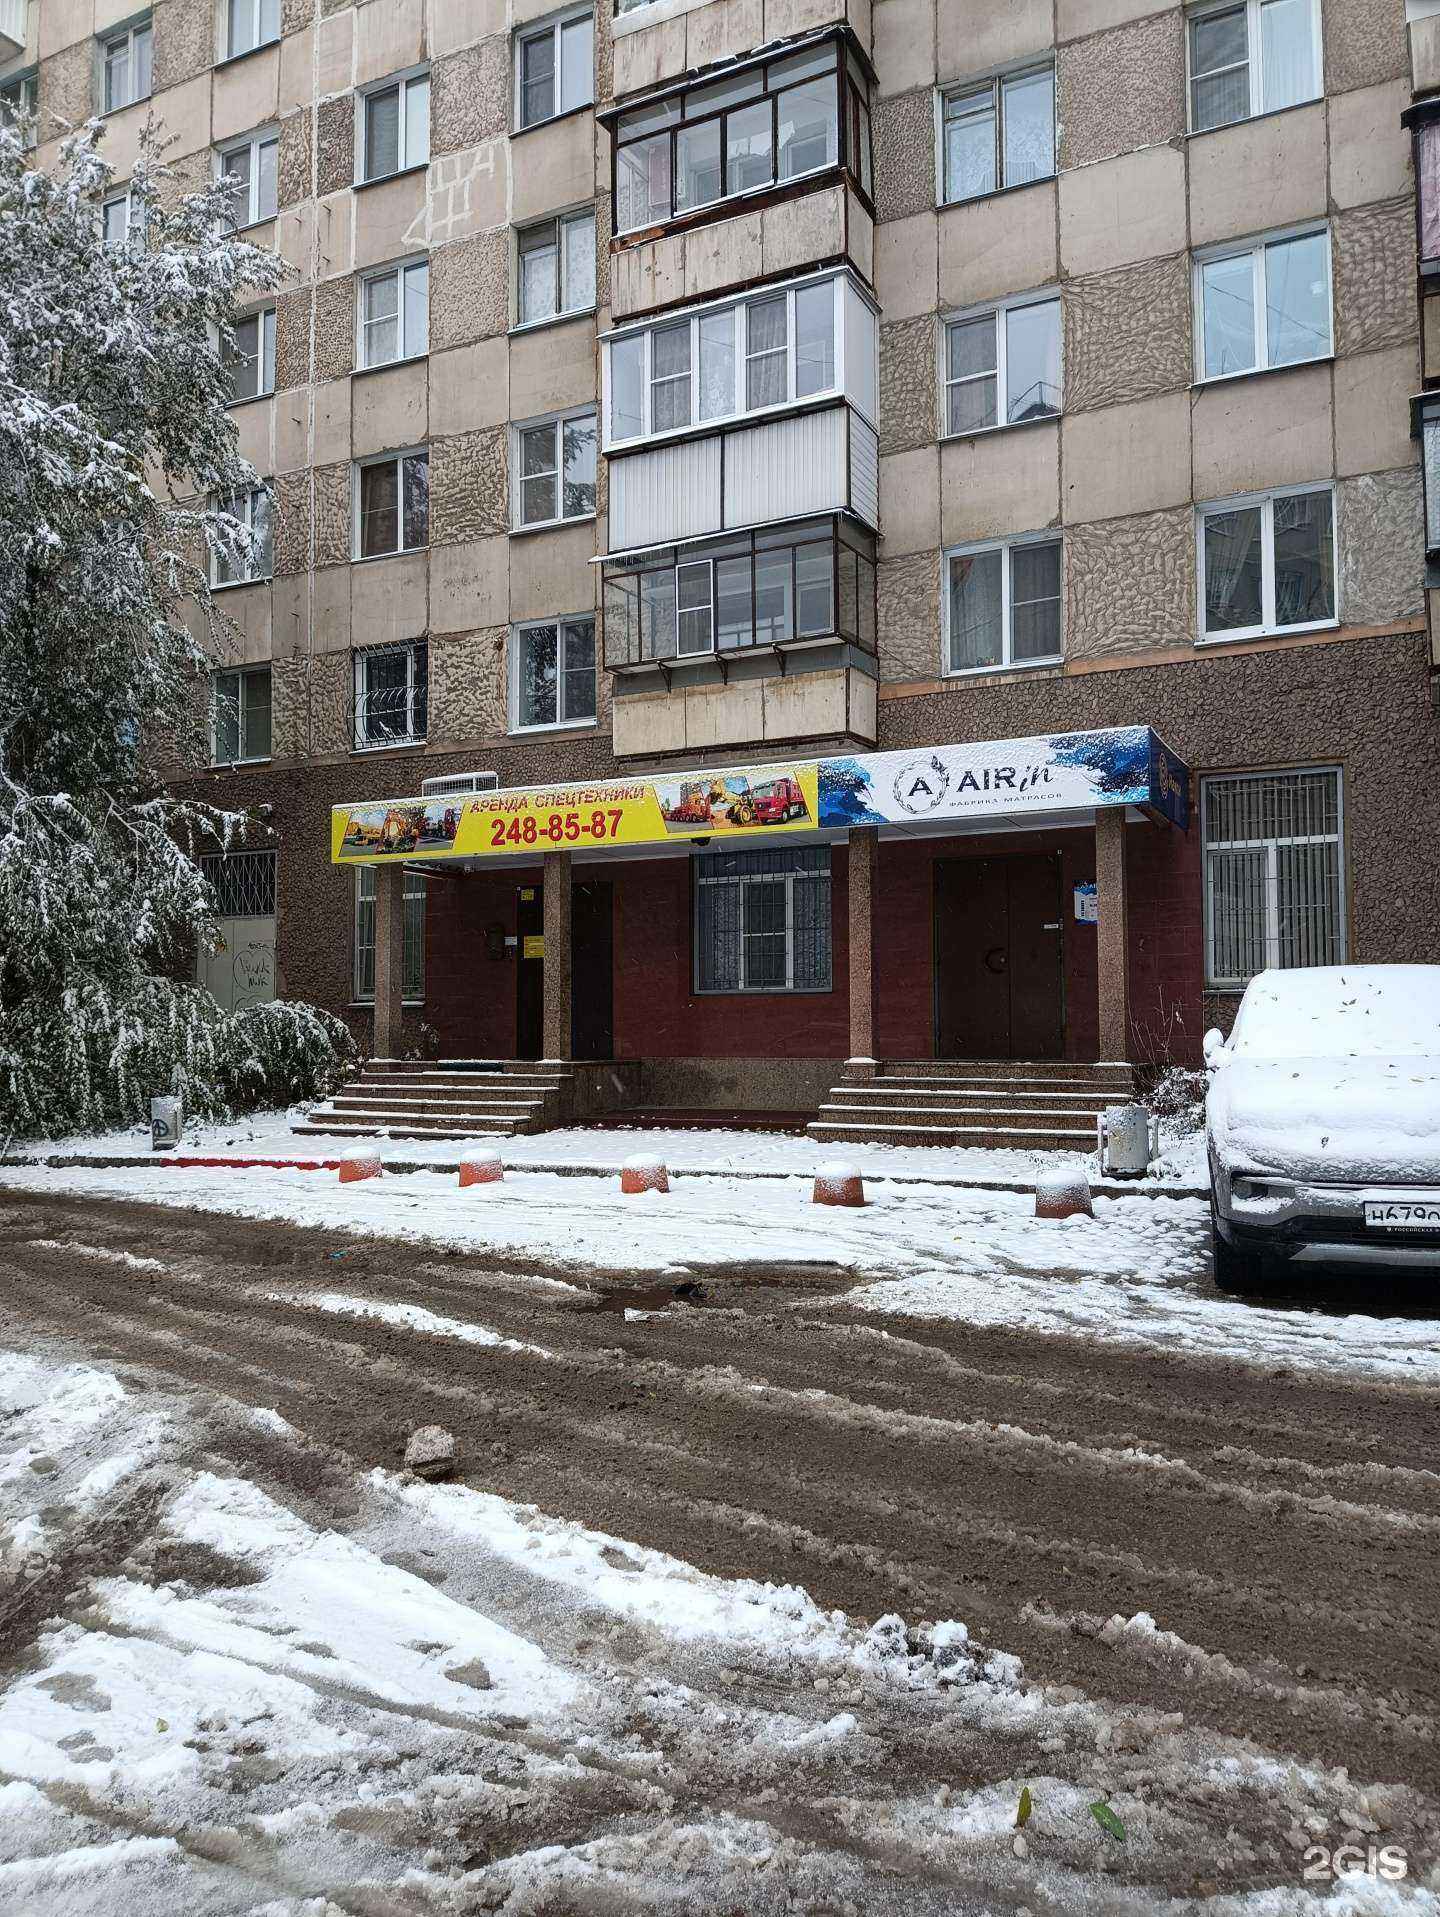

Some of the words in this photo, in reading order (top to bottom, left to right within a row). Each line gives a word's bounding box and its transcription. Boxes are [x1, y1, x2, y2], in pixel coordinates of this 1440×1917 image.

[470, 797, 529, 814] АРЕНДА
[535, 786, 646, 809] СПЕЦТЕХНИКИ
[949, 797, 999, 807] ФАБРИКА
[1003, 793, 1063, 803] МАТРАСОВ
[491, 808, 624, 846] 248-85-87
